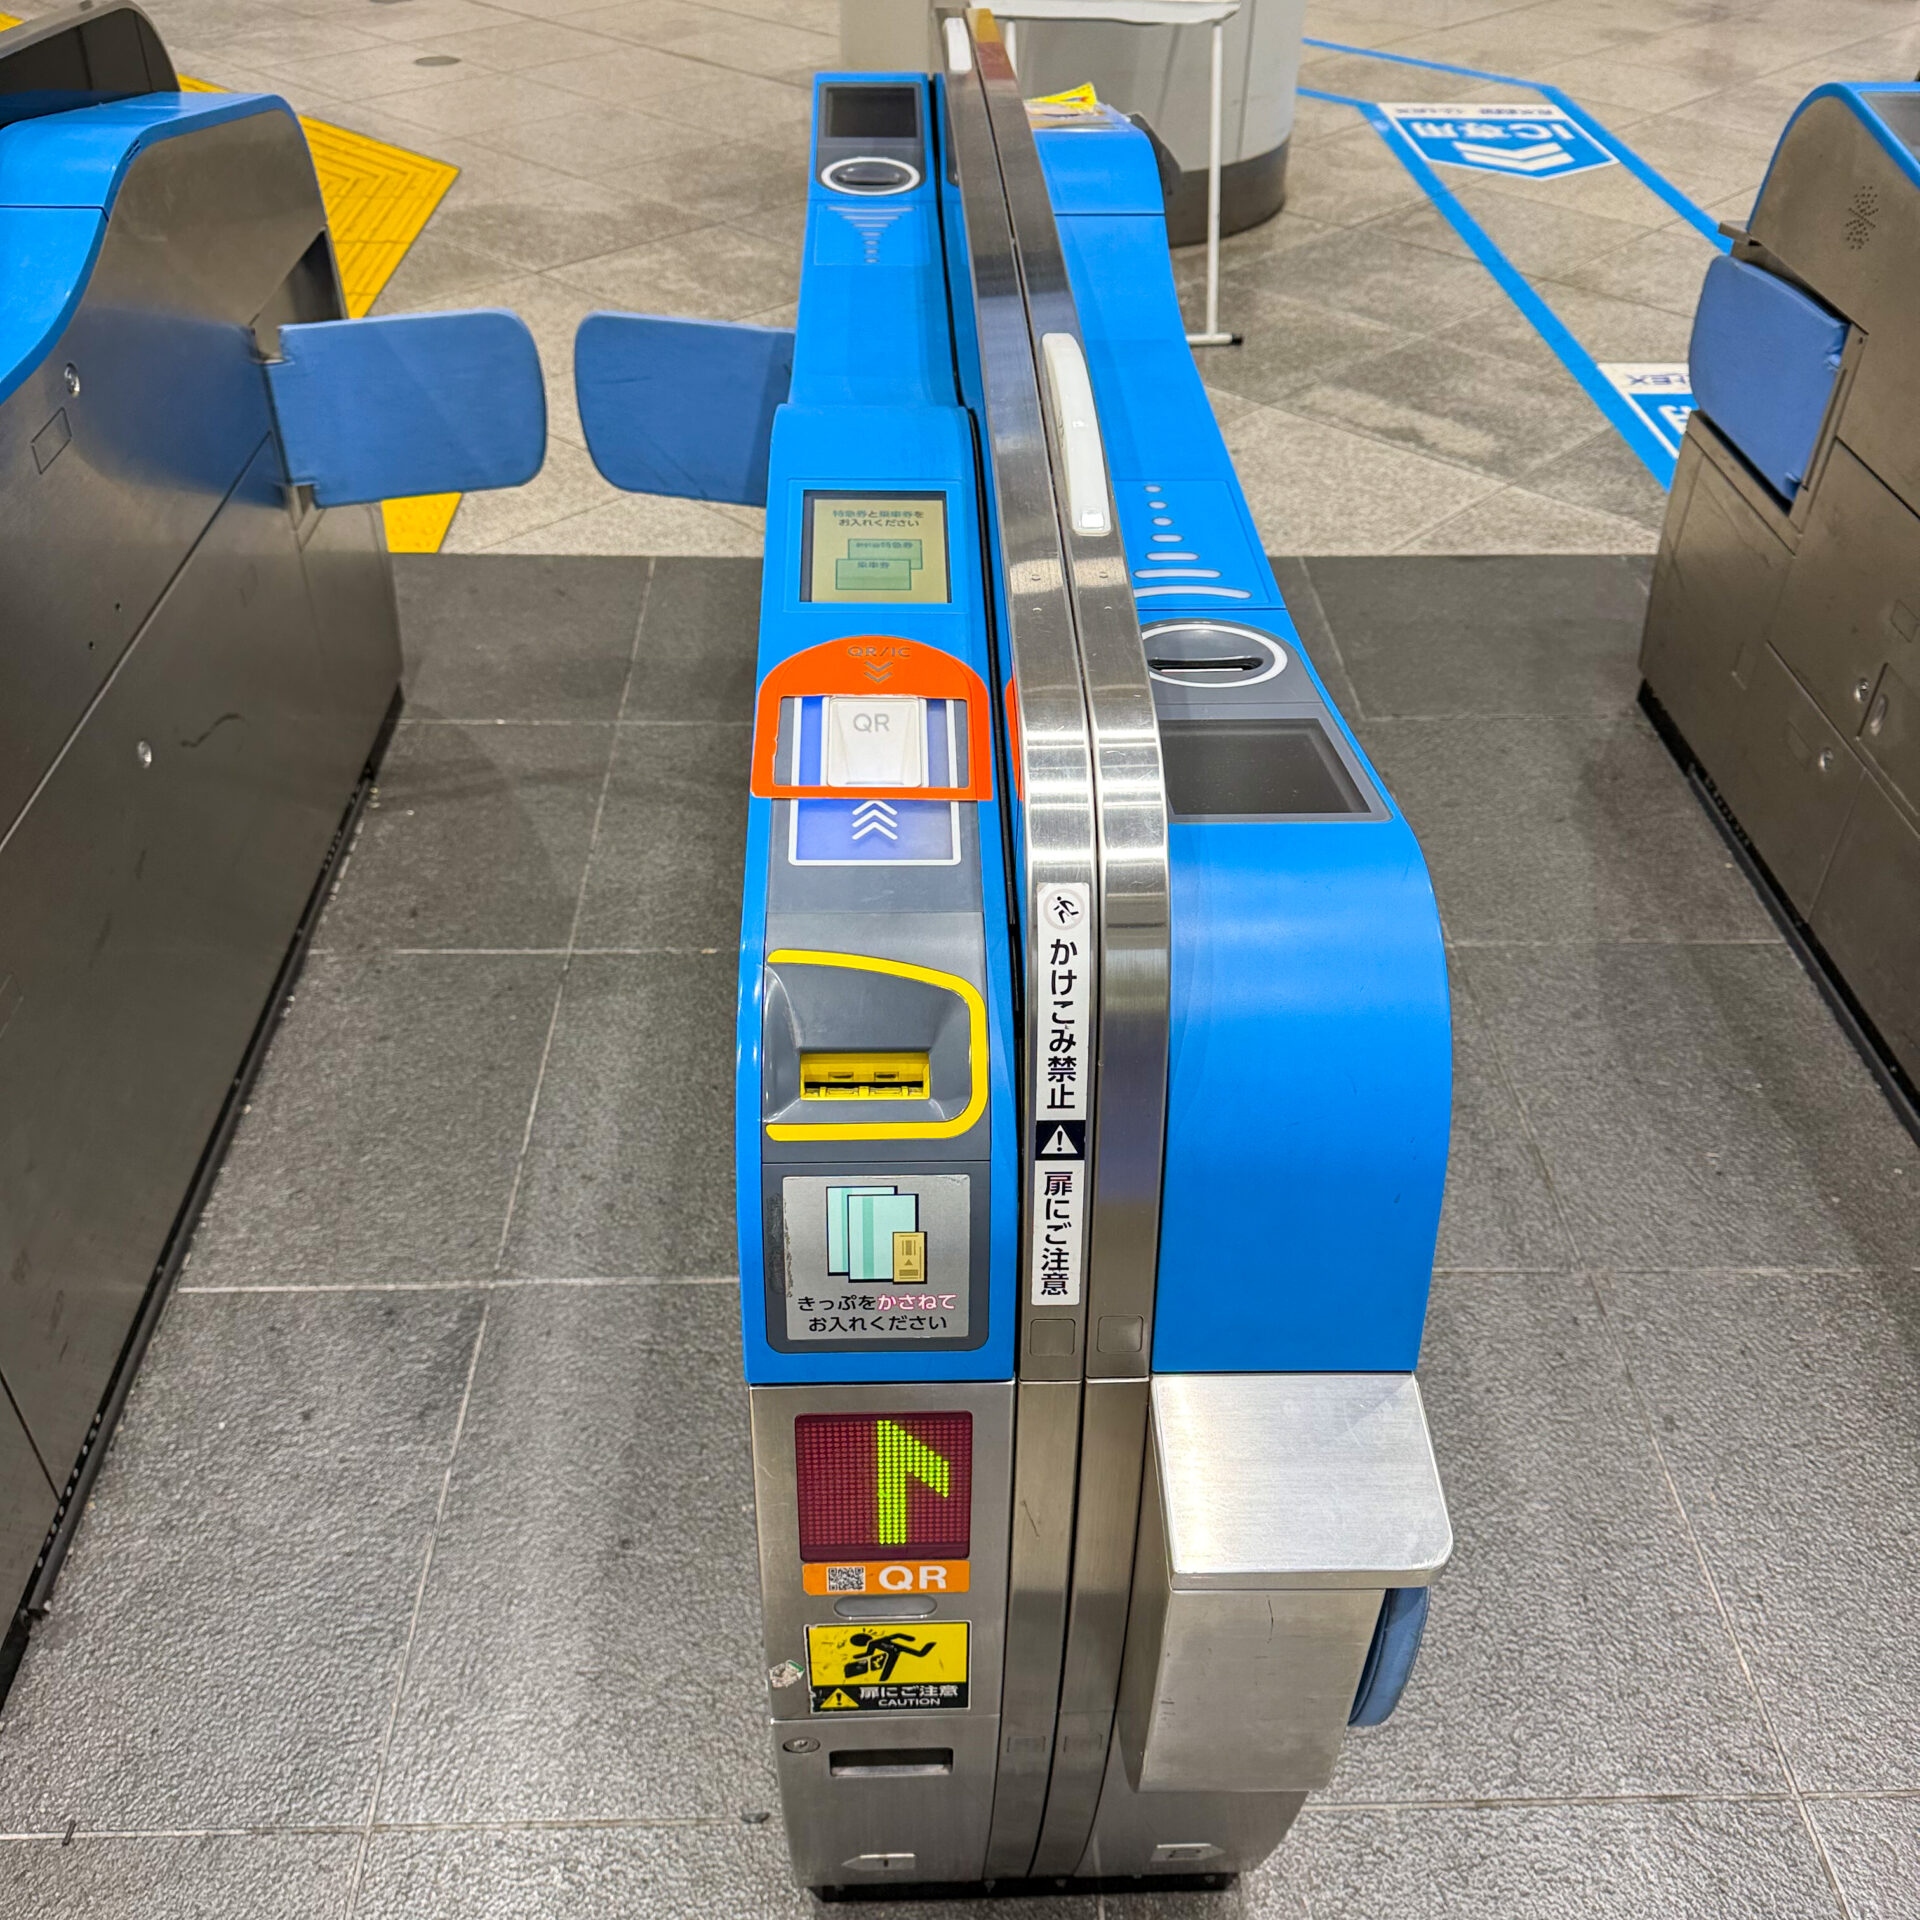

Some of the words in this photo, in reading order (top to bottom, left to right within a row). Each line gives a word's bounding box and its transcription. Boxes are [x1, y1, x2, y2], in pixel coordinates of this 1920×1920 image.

[838, 519, 920, 527] お入れください
[847, 646, 911, 658] QR/IC
[852, 713, 890, 733] QR
[1047, 938, 1078, 1110] かけこみ禁止
[1041, 1171, 1073, 1296] 扉にご注意
[798, 1294, 957, 1311] きっぷをかさねて
[808, 1315, 948, 1333] お入れください
[878, 1565, 948, 1592] QR
[860, 1684, 959, 1699] 扉にご注意
[877, 1698, 941, 1707] CAUTION
